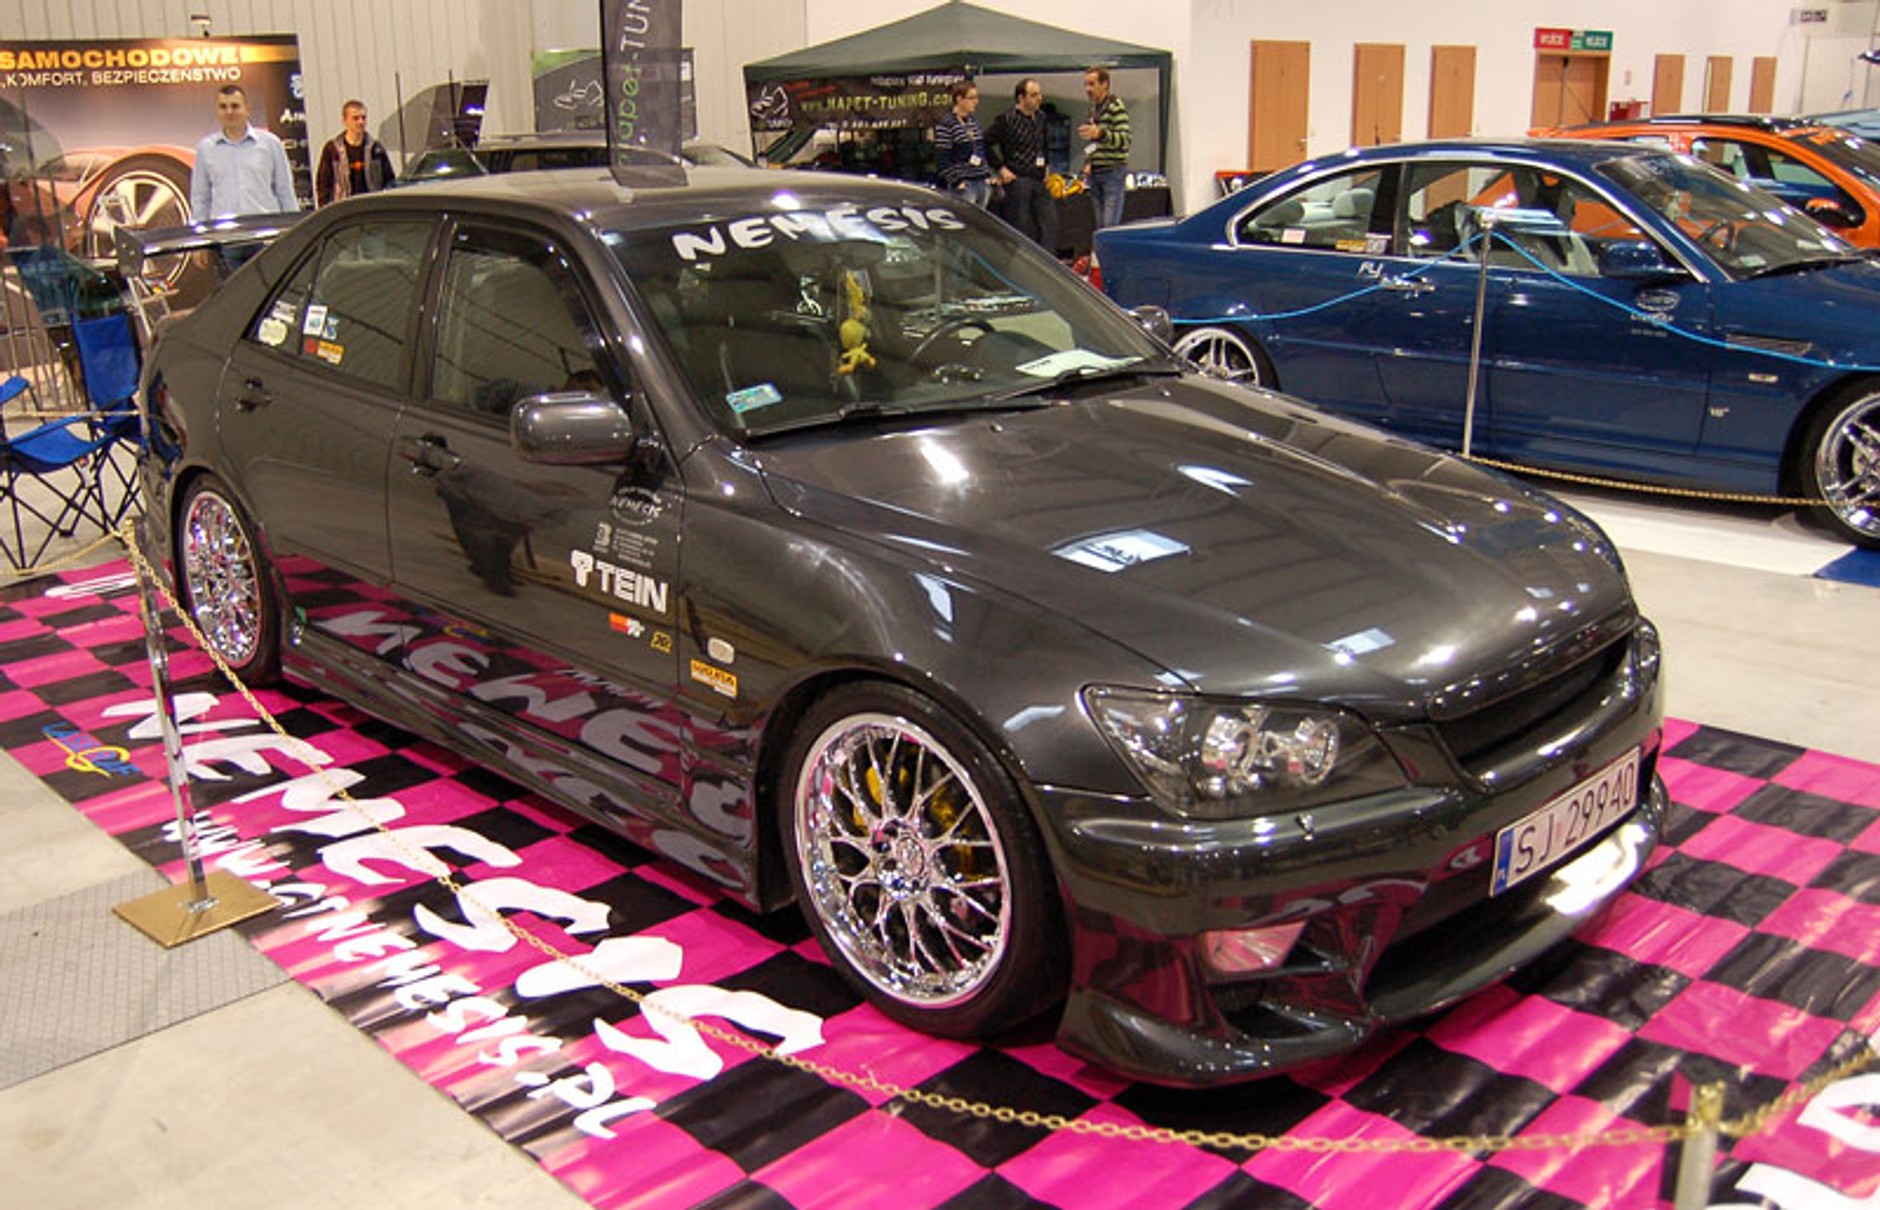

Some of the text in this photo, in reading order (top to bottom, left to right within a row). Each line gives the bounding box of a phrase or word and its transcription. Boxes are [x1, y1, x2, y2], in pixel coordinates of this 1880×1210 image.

[0, 46, 240, 70] SAMOCHODOWE
[672, 206, 966, 261] NEMESIS
[596, 561, 668, 614] TEIN
[1515, 762, 1635, 873] SJ 29940
[101, 691, 826, 1081] NEMESIS
